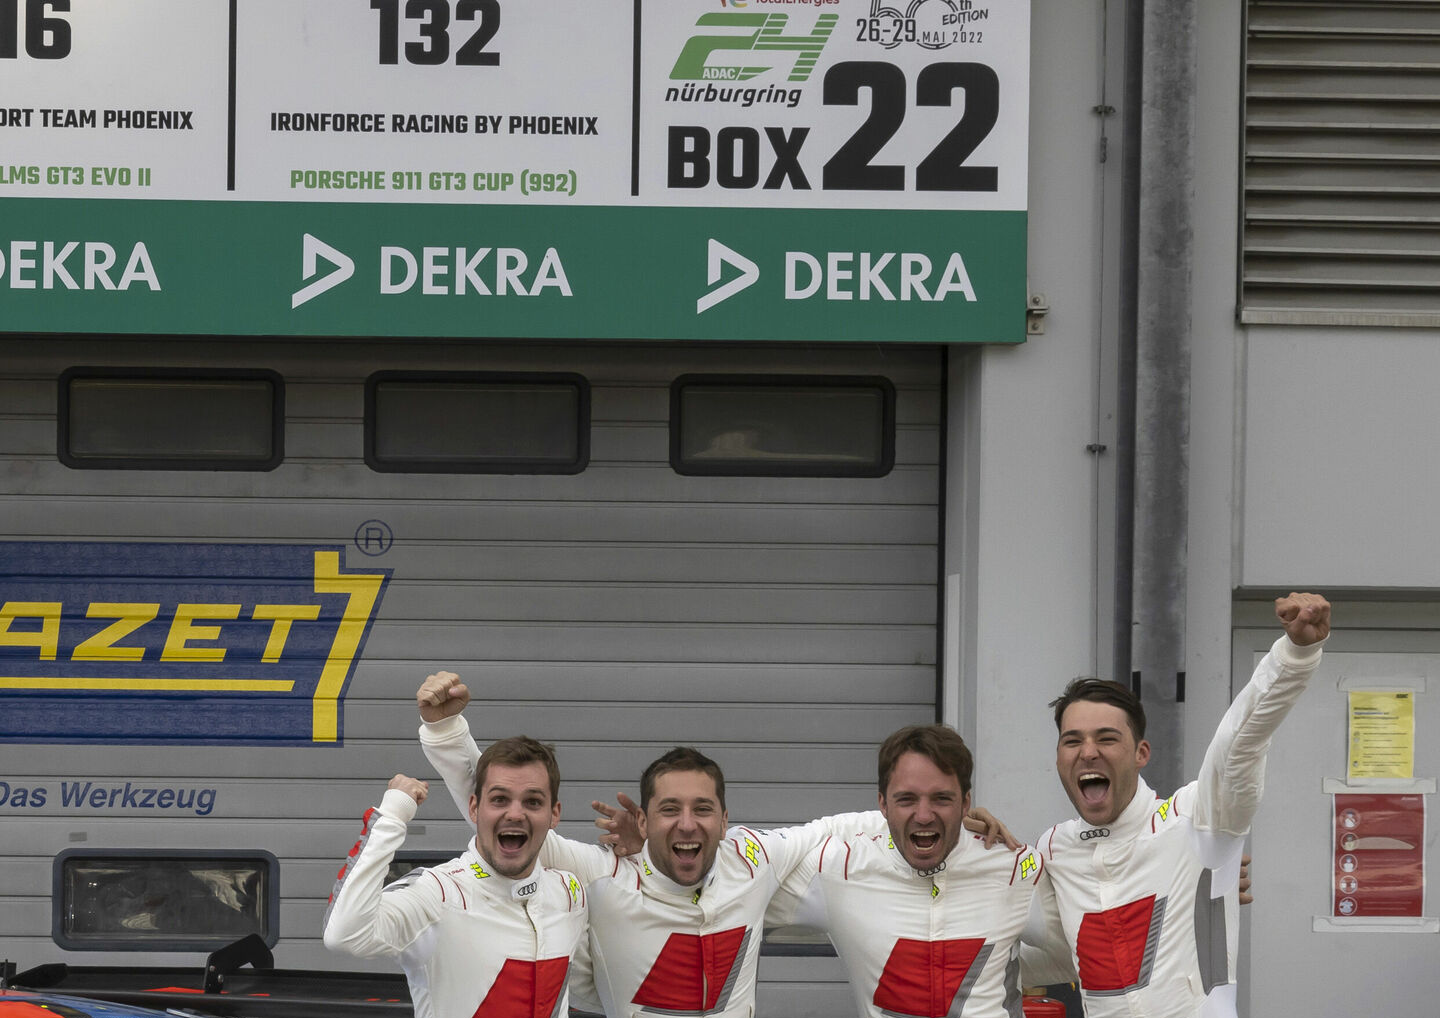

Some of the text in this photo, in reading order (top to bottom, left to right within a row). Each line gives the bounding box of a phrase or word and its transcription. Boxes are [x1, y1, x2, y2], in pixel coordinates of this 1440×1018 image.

[942, 9, 988, 25] EDITION
[370, 0, 501, 66] 132
[922, 31, 983, 43] MAI 2022
[703, 67, 736, 80] ADAC
[665, 83, 802, 107] nürburgring
[40, 109, 97, 128] TEAM
[103, 110, 194, 130] PHOENIX
[270, 113, 598, 135] IRONFORCE RACING BY PHOENIX
[667, 61, 1000, 192] BOX 22
[46, 167, 85, 185] GT3
[91, 167, 132, 186] EVO
[138, 168, 151, 186] II
[290, 169, 578, 196] PORSCHE 911 GT3 CUP (992)
[380, 246, 573, 297] DEKRA
[785, 251, 977, 301] DEKRA
[60, 782, 217, 815] Werkzeug
